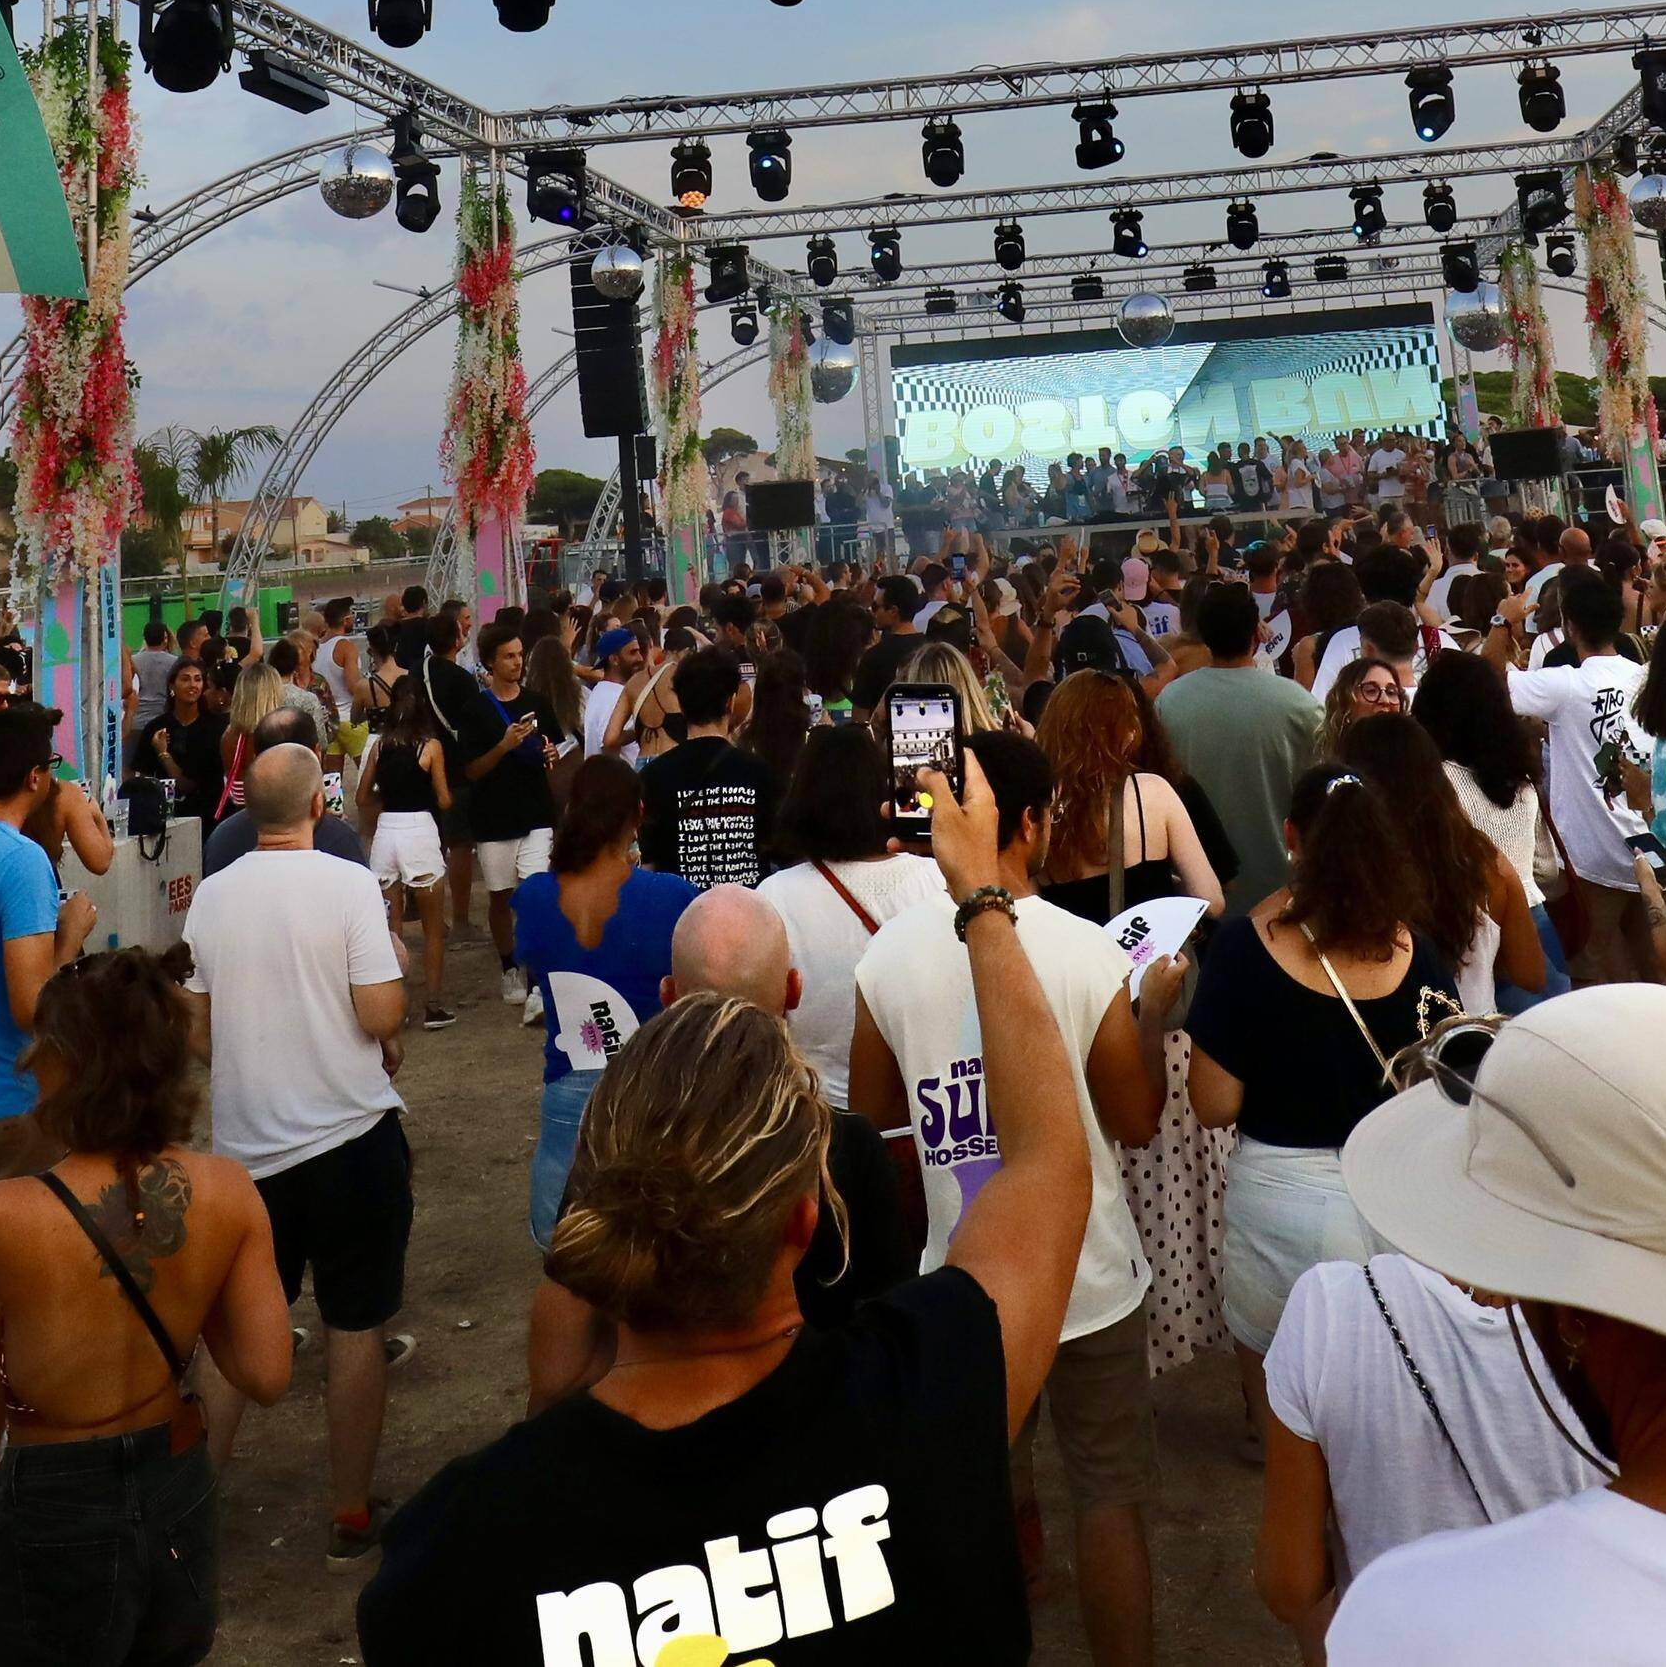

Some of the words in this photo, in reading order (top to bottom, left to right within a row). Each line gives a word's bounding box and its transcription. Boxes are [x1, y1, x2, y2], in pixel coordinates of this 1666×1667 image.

[689, 834, 709, 842] LOVE
[687, 844, 707, 854] LOVE
[686, 854, 707, 862] LOVE
[688, 864, 707, 872] LOVE
[711, 864, 723, 872] THE
[689, 874, 711, 882] LOVE
[1116, 916, 1151, 951] tif
[1133, 946, 1149, 961] STVL
[589, 999, 626, 1062] nati
[924, 1137, 998, 1166] HOSSE
[536, 1484, 895, 1667] natif
